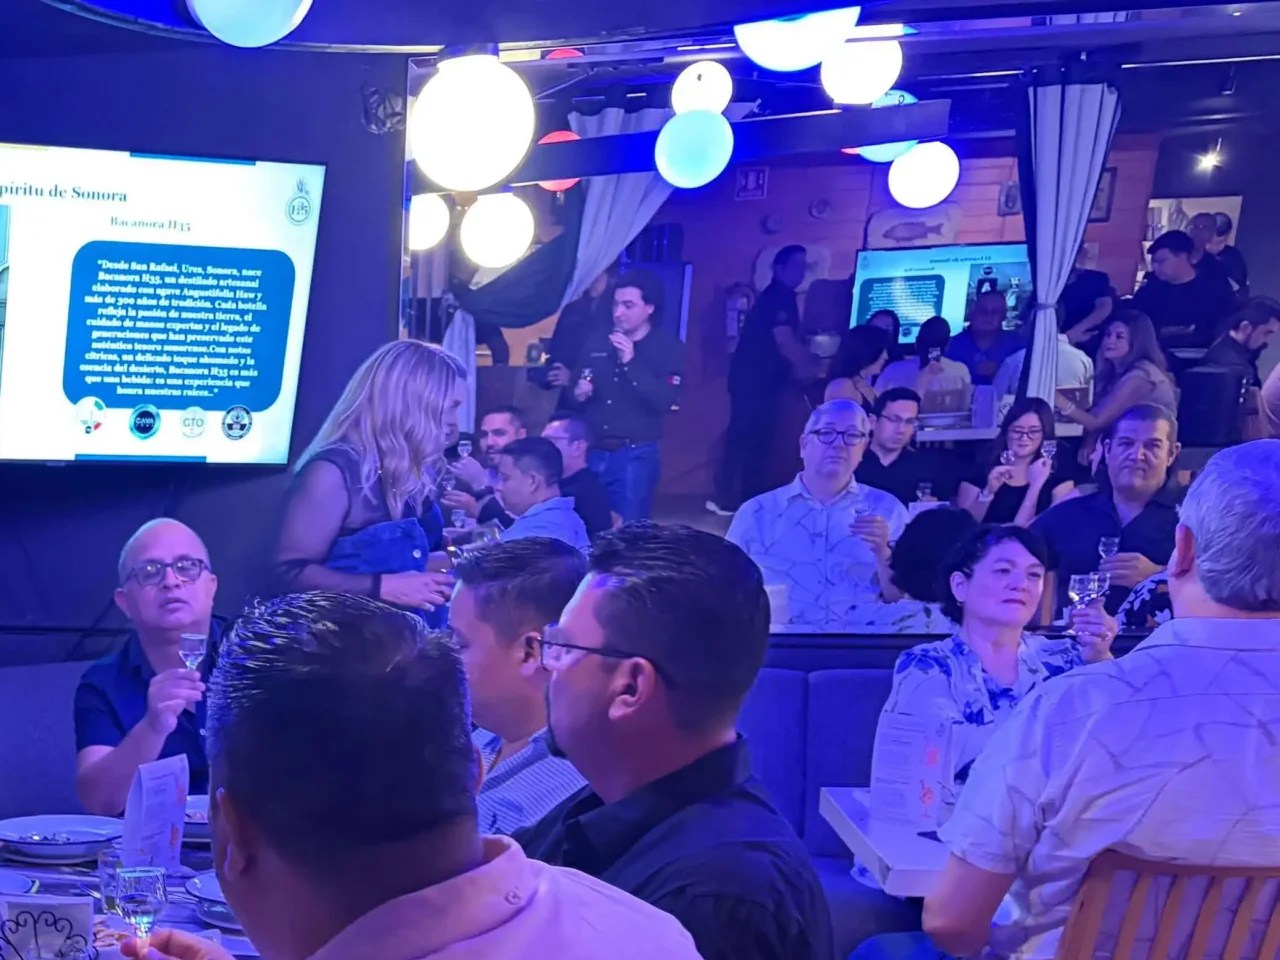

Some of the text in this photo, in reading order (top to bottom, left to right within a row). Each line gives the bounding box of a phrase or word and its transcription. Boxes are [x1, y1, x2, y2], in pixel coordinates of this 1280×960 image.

[48, 184, 67, 198] de
[70, 186, 127, 202] Sonora
[110, 216, 165, 229] Bacanora
[97, 260, 128, 269] "Desde
[130, 262, 147, 270] San
[149, 263, 179, 273] Rafael,
[206, 266, 240, 276] Sonora,
[241, 269, 262, 277] nace
[98, 271, 140, 281] Bacanora
[178, 275, 217, 285] destilado
[219, 277, 259, 287] artesanal
[92, 283, 136, 293] elaborado
[156, 287, 181, 296] agave
[84, 294, 267, 310] más de 300 años de tradición. Cada botella
[98, 306, 252, 321] refleja la pasión de nuestra tierra, el
[86, 317, 121, 327] cuidado
[123, 318, 134, 327] de
[135, 320, 165, 328] manos
[166, 320, 203, 331] expertas
[211, 322, 219, 330] el
[220, 322, 248, 333] legado
[249, 323, 260, 332] de
[91, 329, 253, 343] generaciones que han preservado este
[91, 341, 132, 350] auténtico
[134, 343, 161, 351] tesoro
[227, 346, 251, 354] notas
[135, 353, 171, 362] delicado
[173, 354, 197, 364] toque
[199, 355, 238, 364] ahumado
[246, 356, 254, 364] la
[79, 363, 112, 371] esencia
[113, 364, 127, 372] del
[168, 365, 208, 374] Bacanora
[240, 368, 257, 376] más
[85, 375, 101, 384] que
[184, 377, 232, 388] experiencia
[234, 380, 250, 388] que
[116, 386, 142, 394] honra
[144, 386, 181, 395] nuestras
[183, 418, 205, 428] GTO
